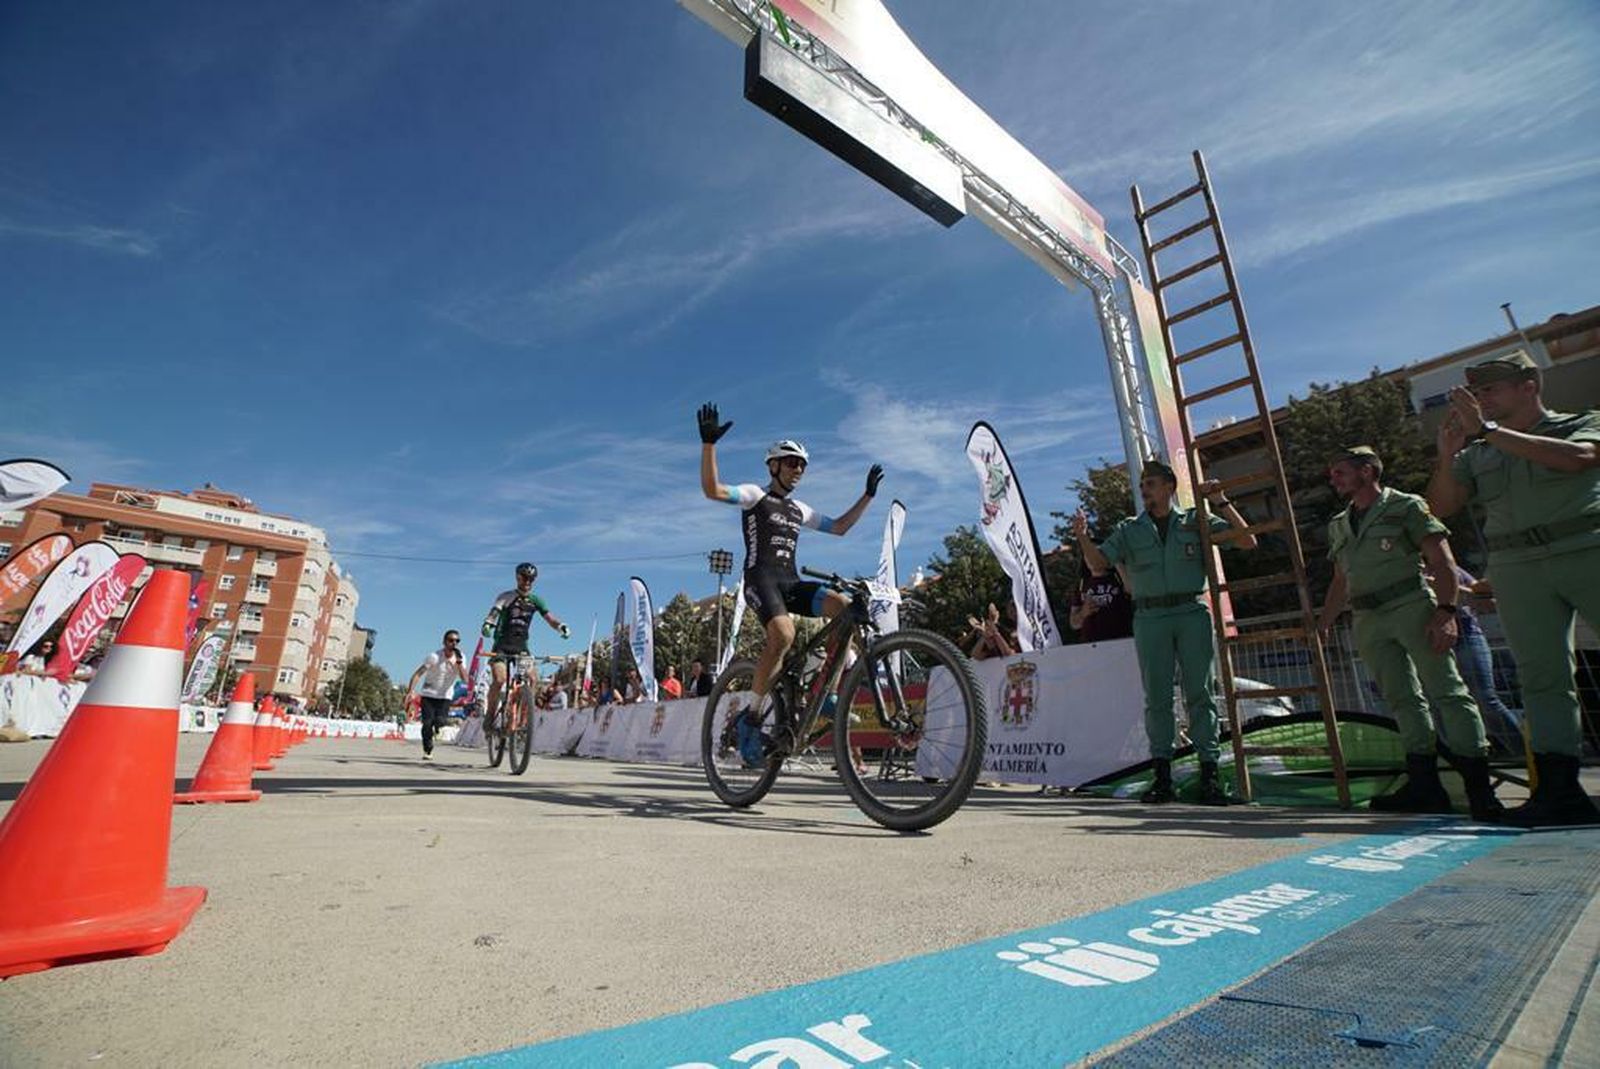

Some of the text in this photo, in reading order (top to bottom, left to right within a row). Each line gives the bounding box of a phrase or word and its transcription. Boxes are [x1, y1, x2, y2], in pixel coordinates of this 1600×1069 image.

[987, 742, 1065, 756] NTAMIENTO
[990, 757, 1048, 774] ALMERÍA
[1127, 882, 1319, 946] cajamar
